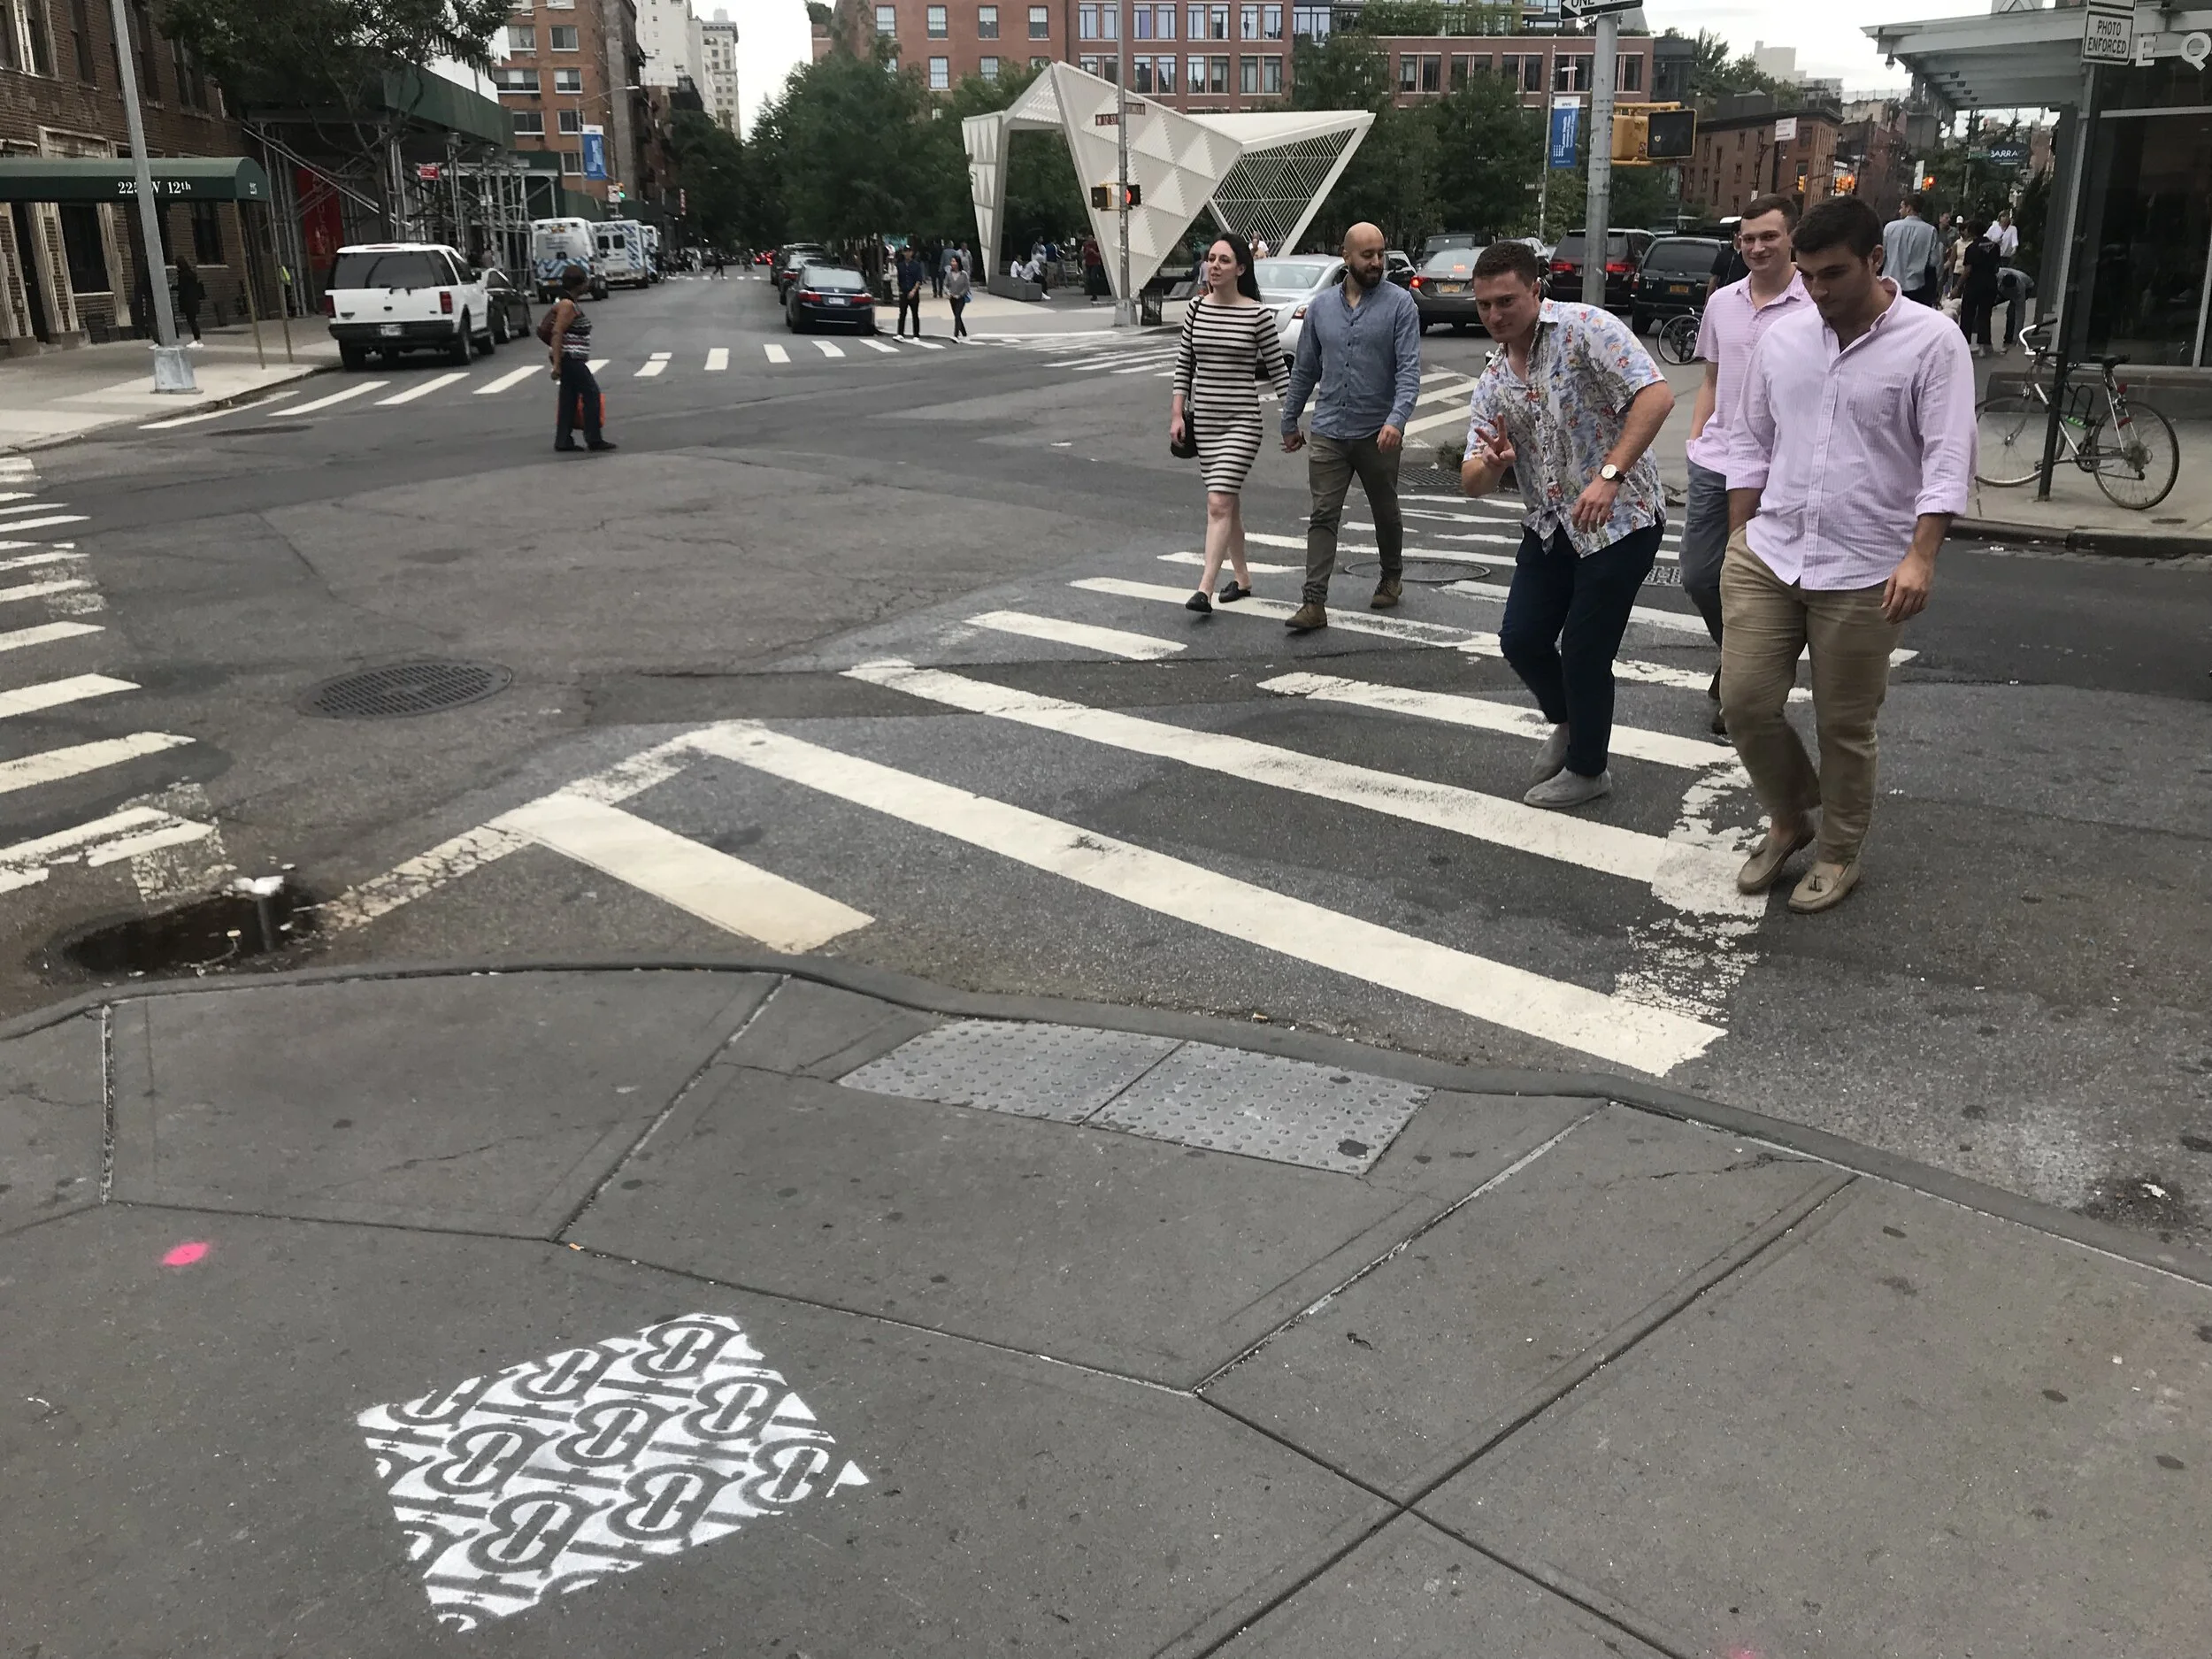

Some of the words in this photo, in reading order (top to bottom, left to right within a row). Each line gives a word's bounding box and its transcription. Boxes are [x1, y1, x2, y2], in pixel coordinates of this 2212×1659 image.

[2097, 19, 2122, 36] PHOTO
[2087, 36, 2127, 54] ENFORCED
[1990, 150, 2029, 158] BARRA
[166, 180, 192, 194] 12th
